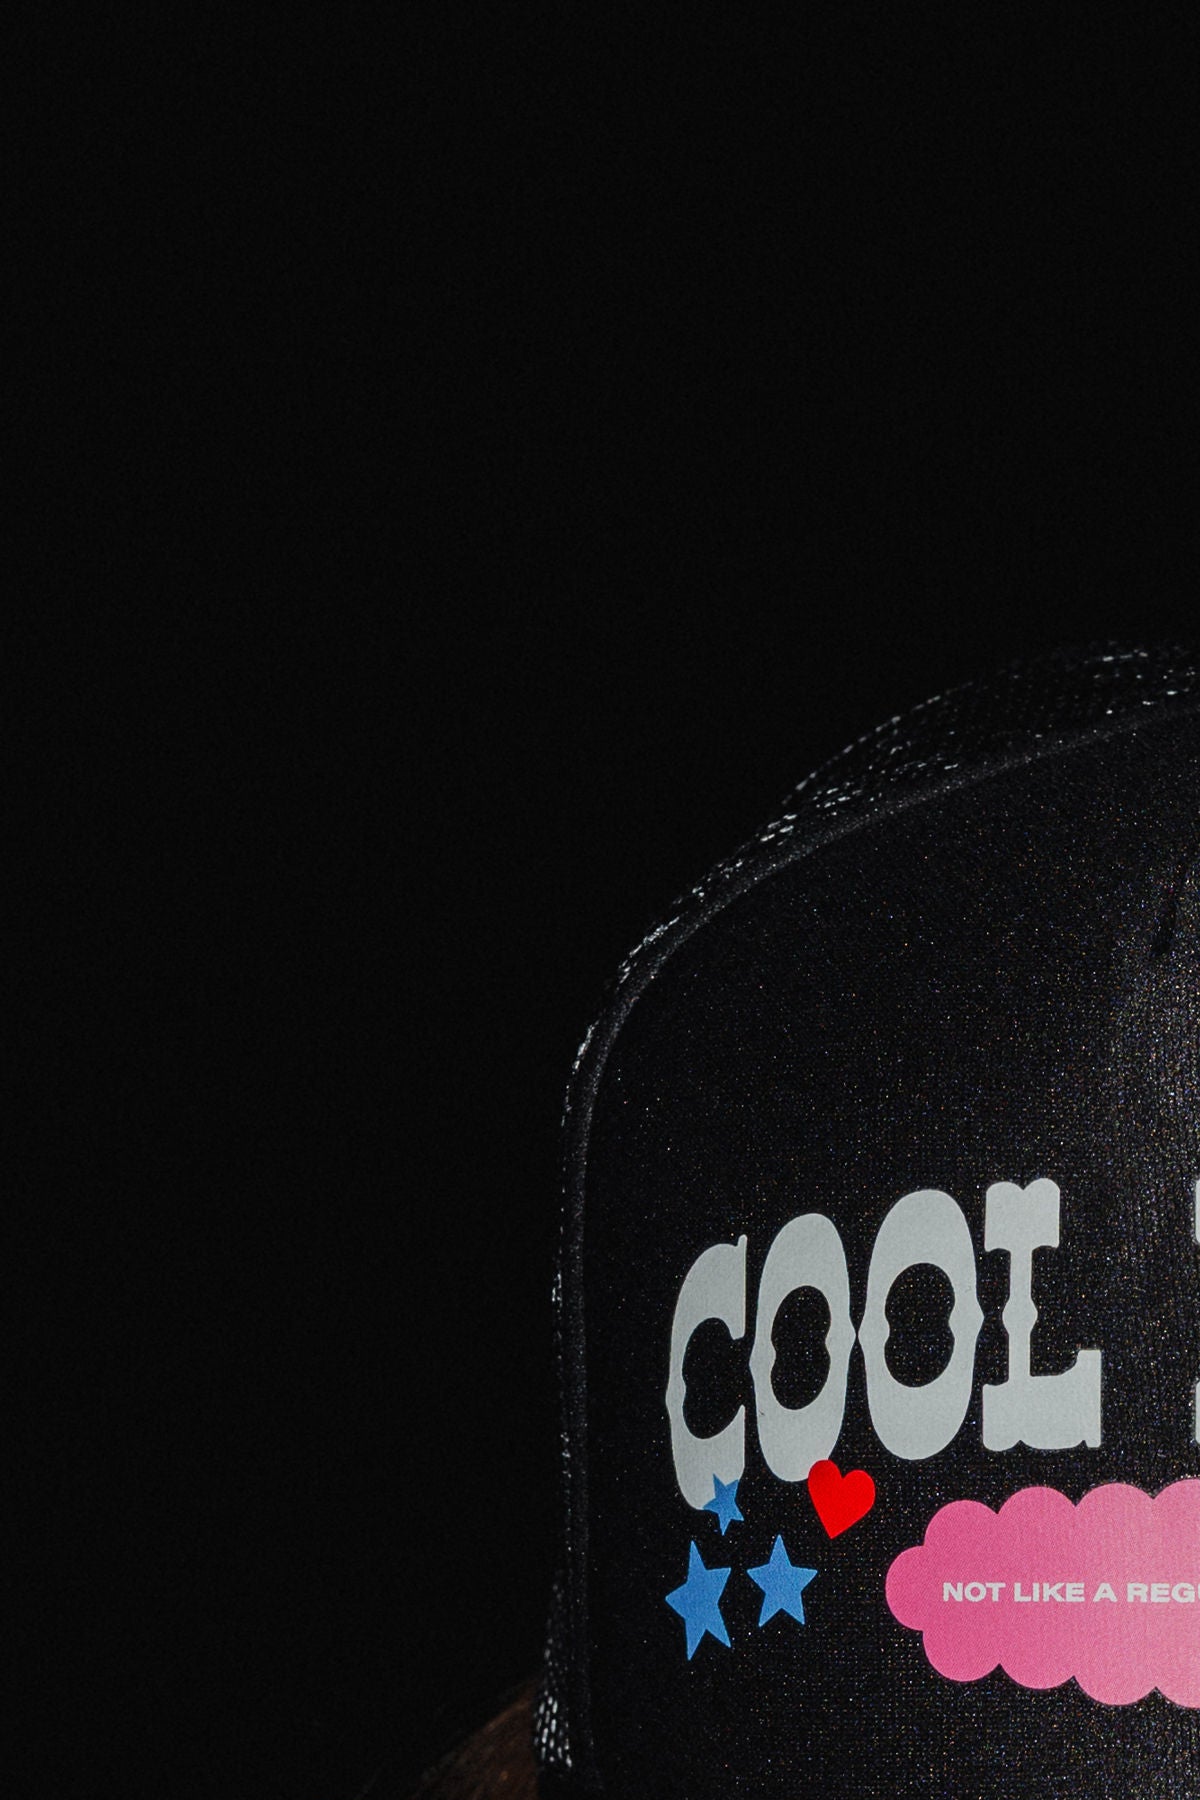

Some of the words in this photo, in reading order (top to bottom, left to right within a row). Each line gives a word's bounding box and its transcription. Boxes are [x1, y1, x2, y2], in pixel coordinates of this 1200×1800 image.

[665, 1177, 1102, 1511] COOL
[942, 1581, 1006, 1603] NOT
[1013, 1582, 1086, 1603] LIKE
[1092, 1582, 1119, 1603] A
